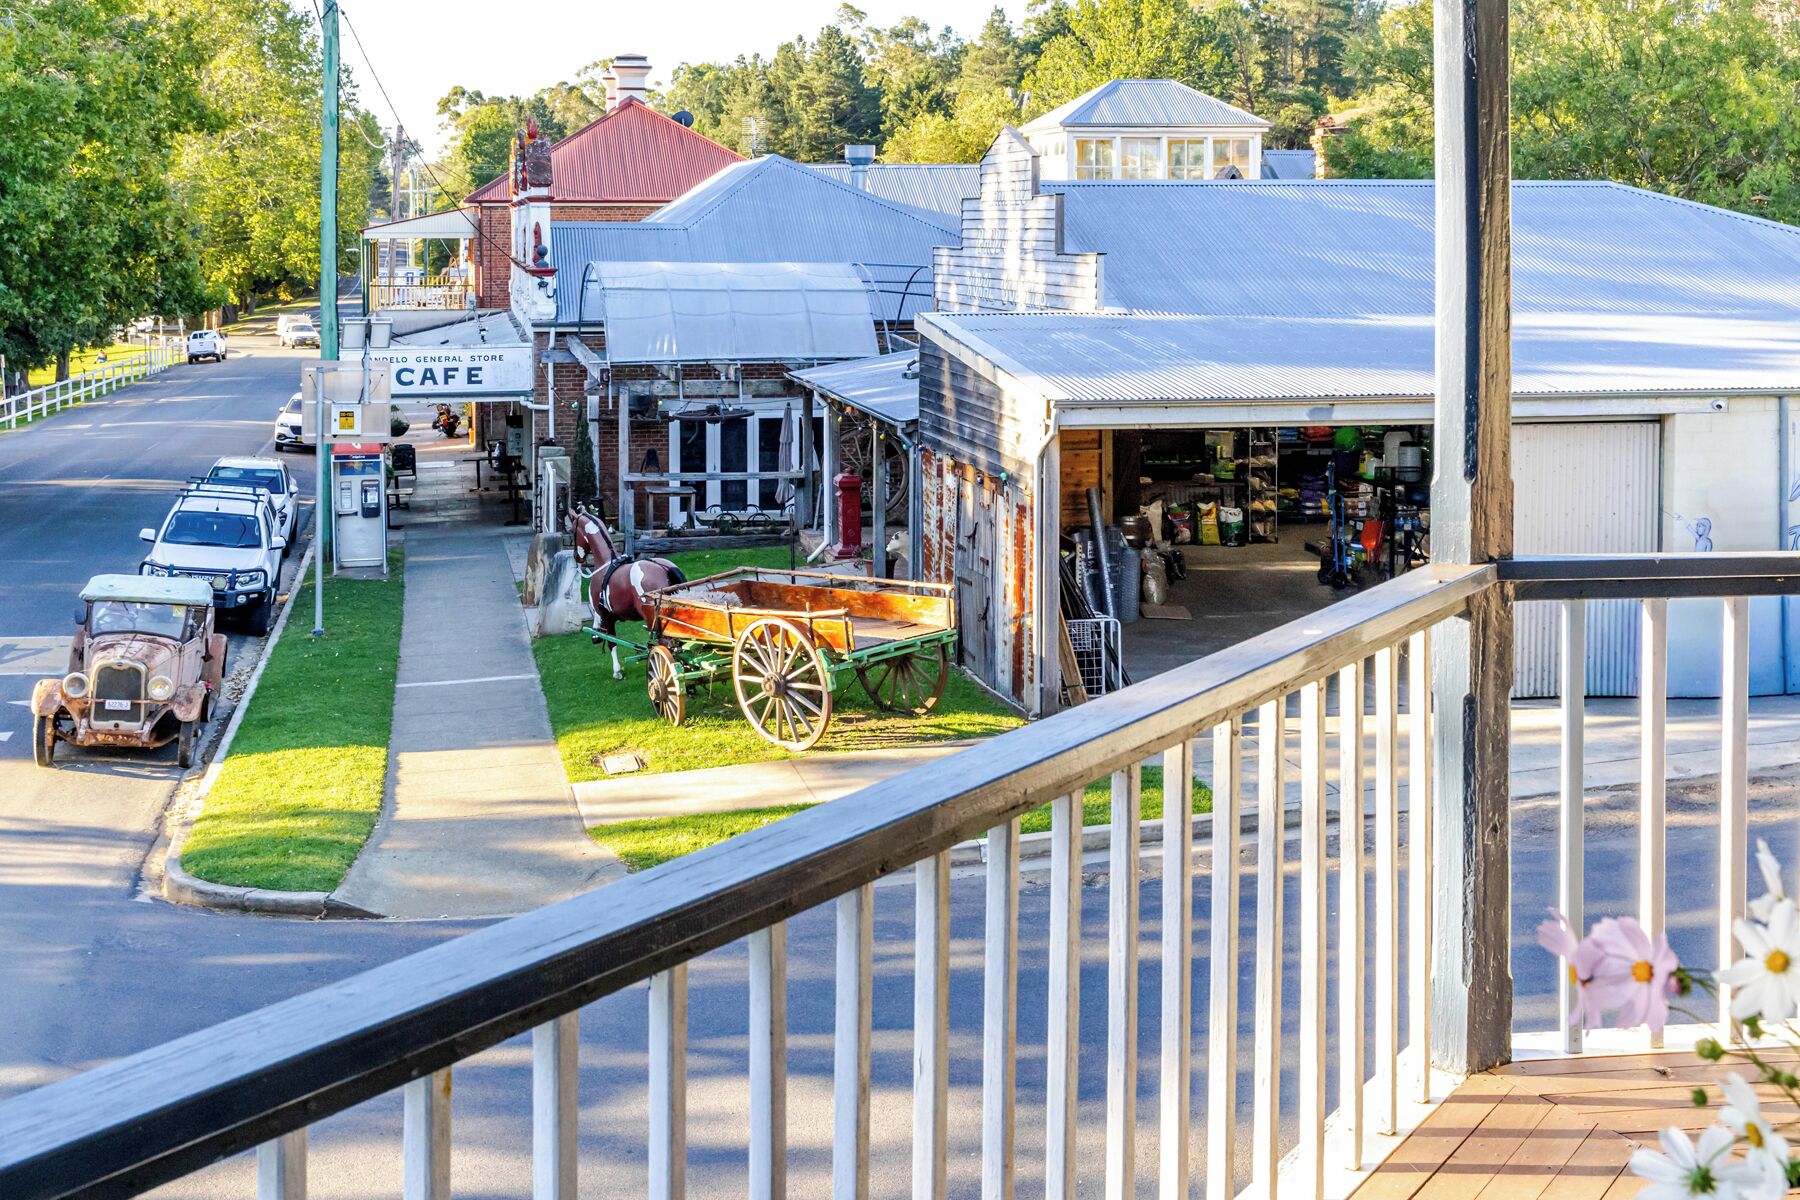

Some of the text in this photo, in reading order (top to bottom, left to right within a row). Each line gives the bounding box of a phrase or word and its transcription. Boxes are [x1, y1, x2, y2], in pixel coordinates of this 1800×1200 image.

[415, 355, 463, 363] GENERAL
[470, 354, 504, 362] STORE
[395, 366, 483, 386] CAFE
